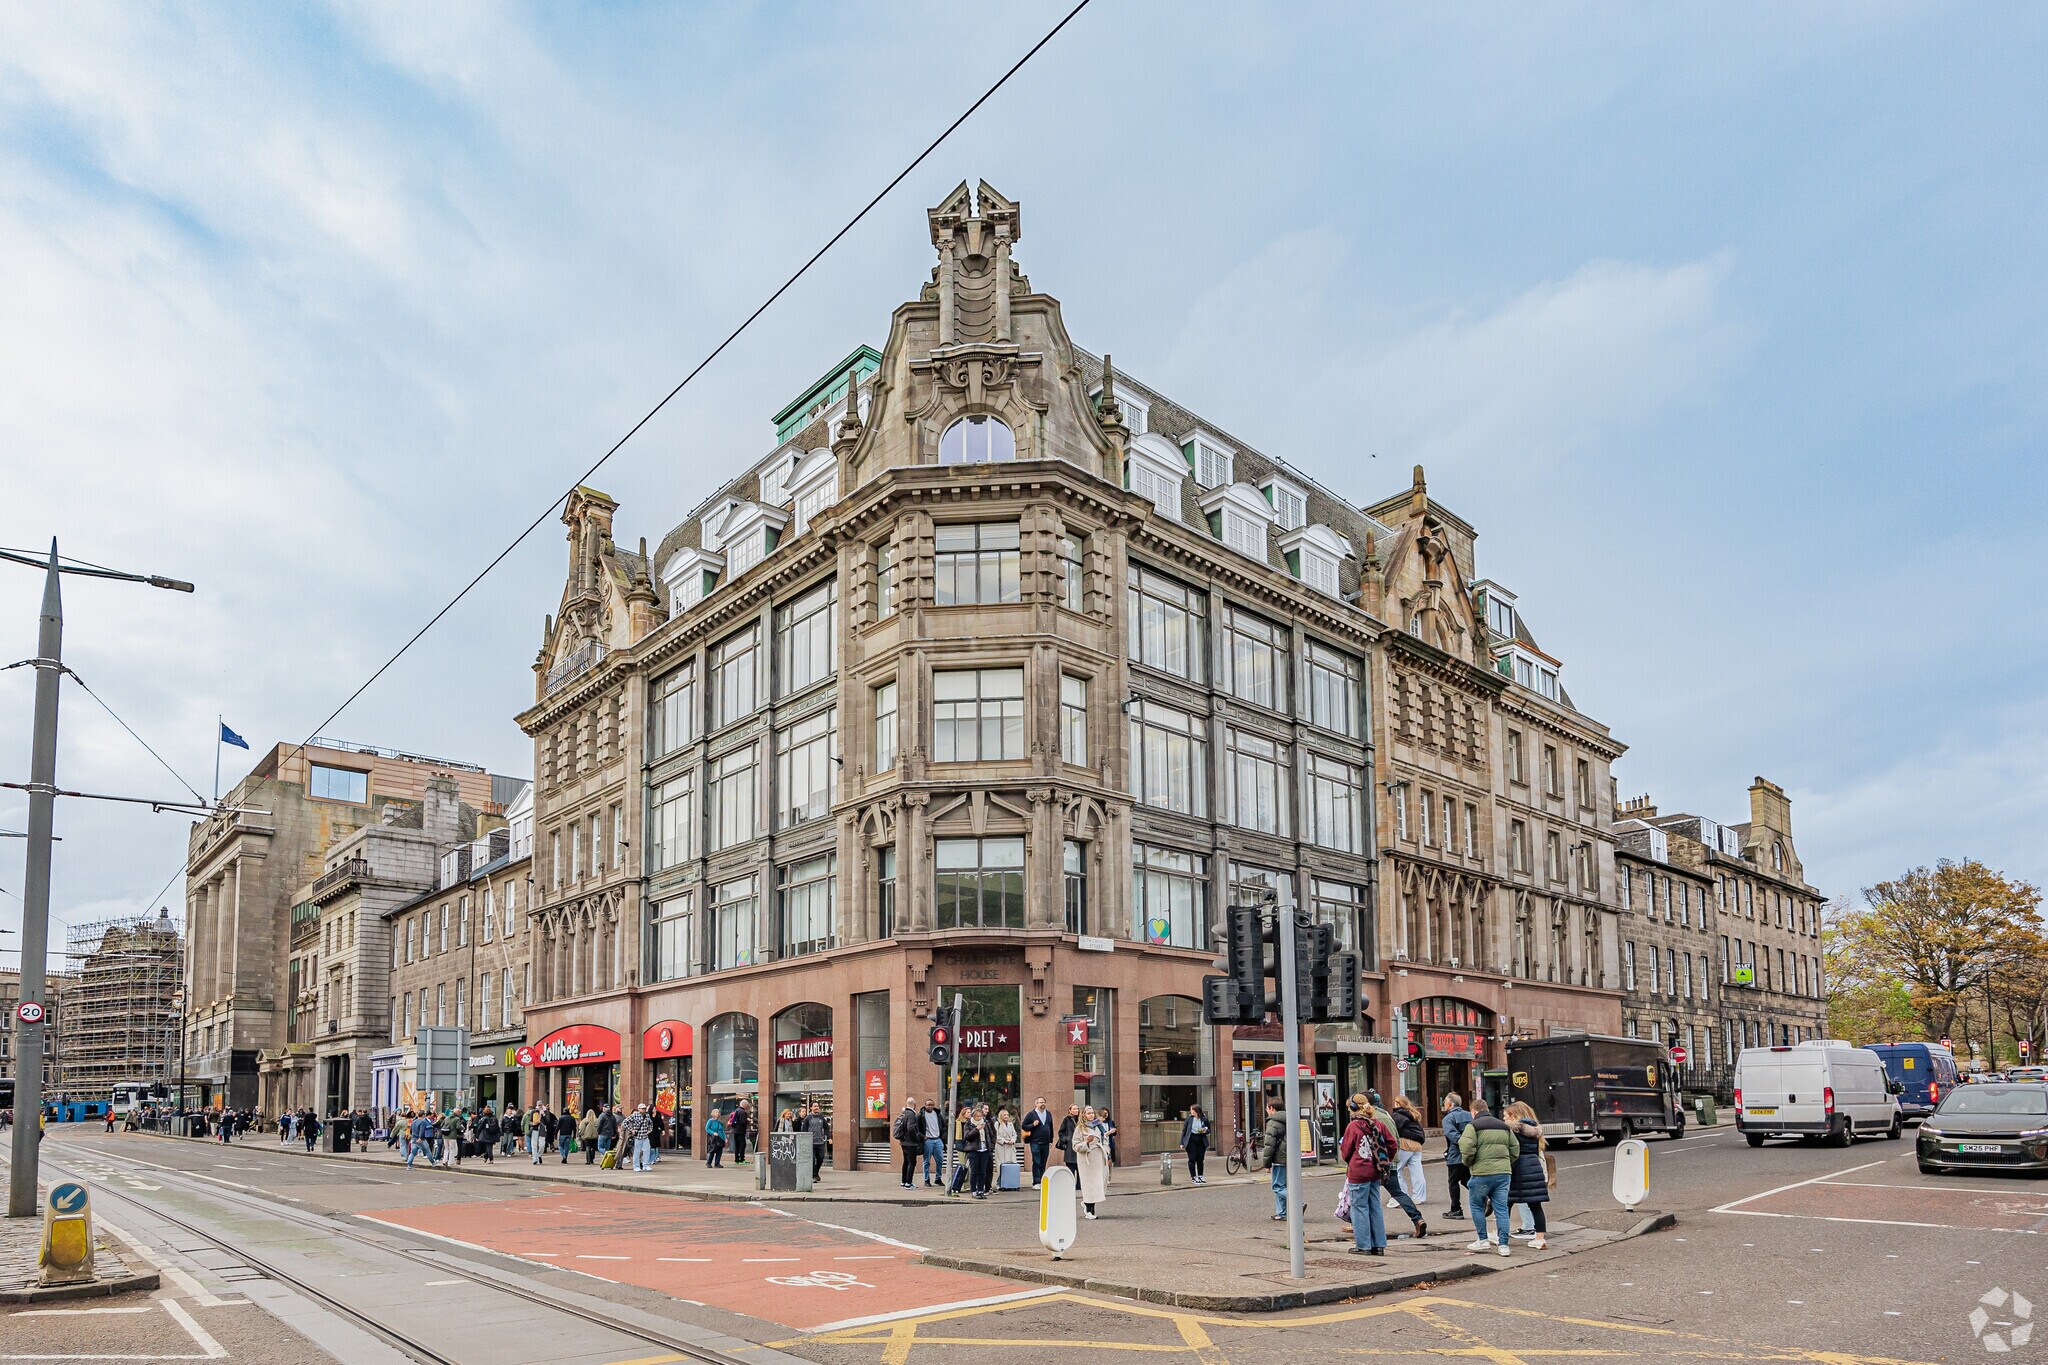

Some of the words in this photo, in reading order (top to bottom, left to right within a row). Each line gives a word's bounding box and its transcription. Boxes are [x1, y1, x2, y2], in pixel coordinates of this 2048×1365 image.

[945, 955, 1015, 966] CHARLOTTE
[960, 969, 999, 980] HOUSE
[22, 1007, 40, 1017] 20
[1410, 1006, 1475, 1025] YEEHAW
[966, 1030, 995, 1047] PRET
[1378, 1036, 1392, 1044] HOUS
[540, 1039, 581, 1062] Jollibee
[783, 1043, 797, 1059] PRET
[798, 1042, 805, 1058] A
[804, 1041, 830, 1057] MANGER
[469, 1054, 496, 1067] Donald's
[1514, 1075, 1528, 1086] ups
